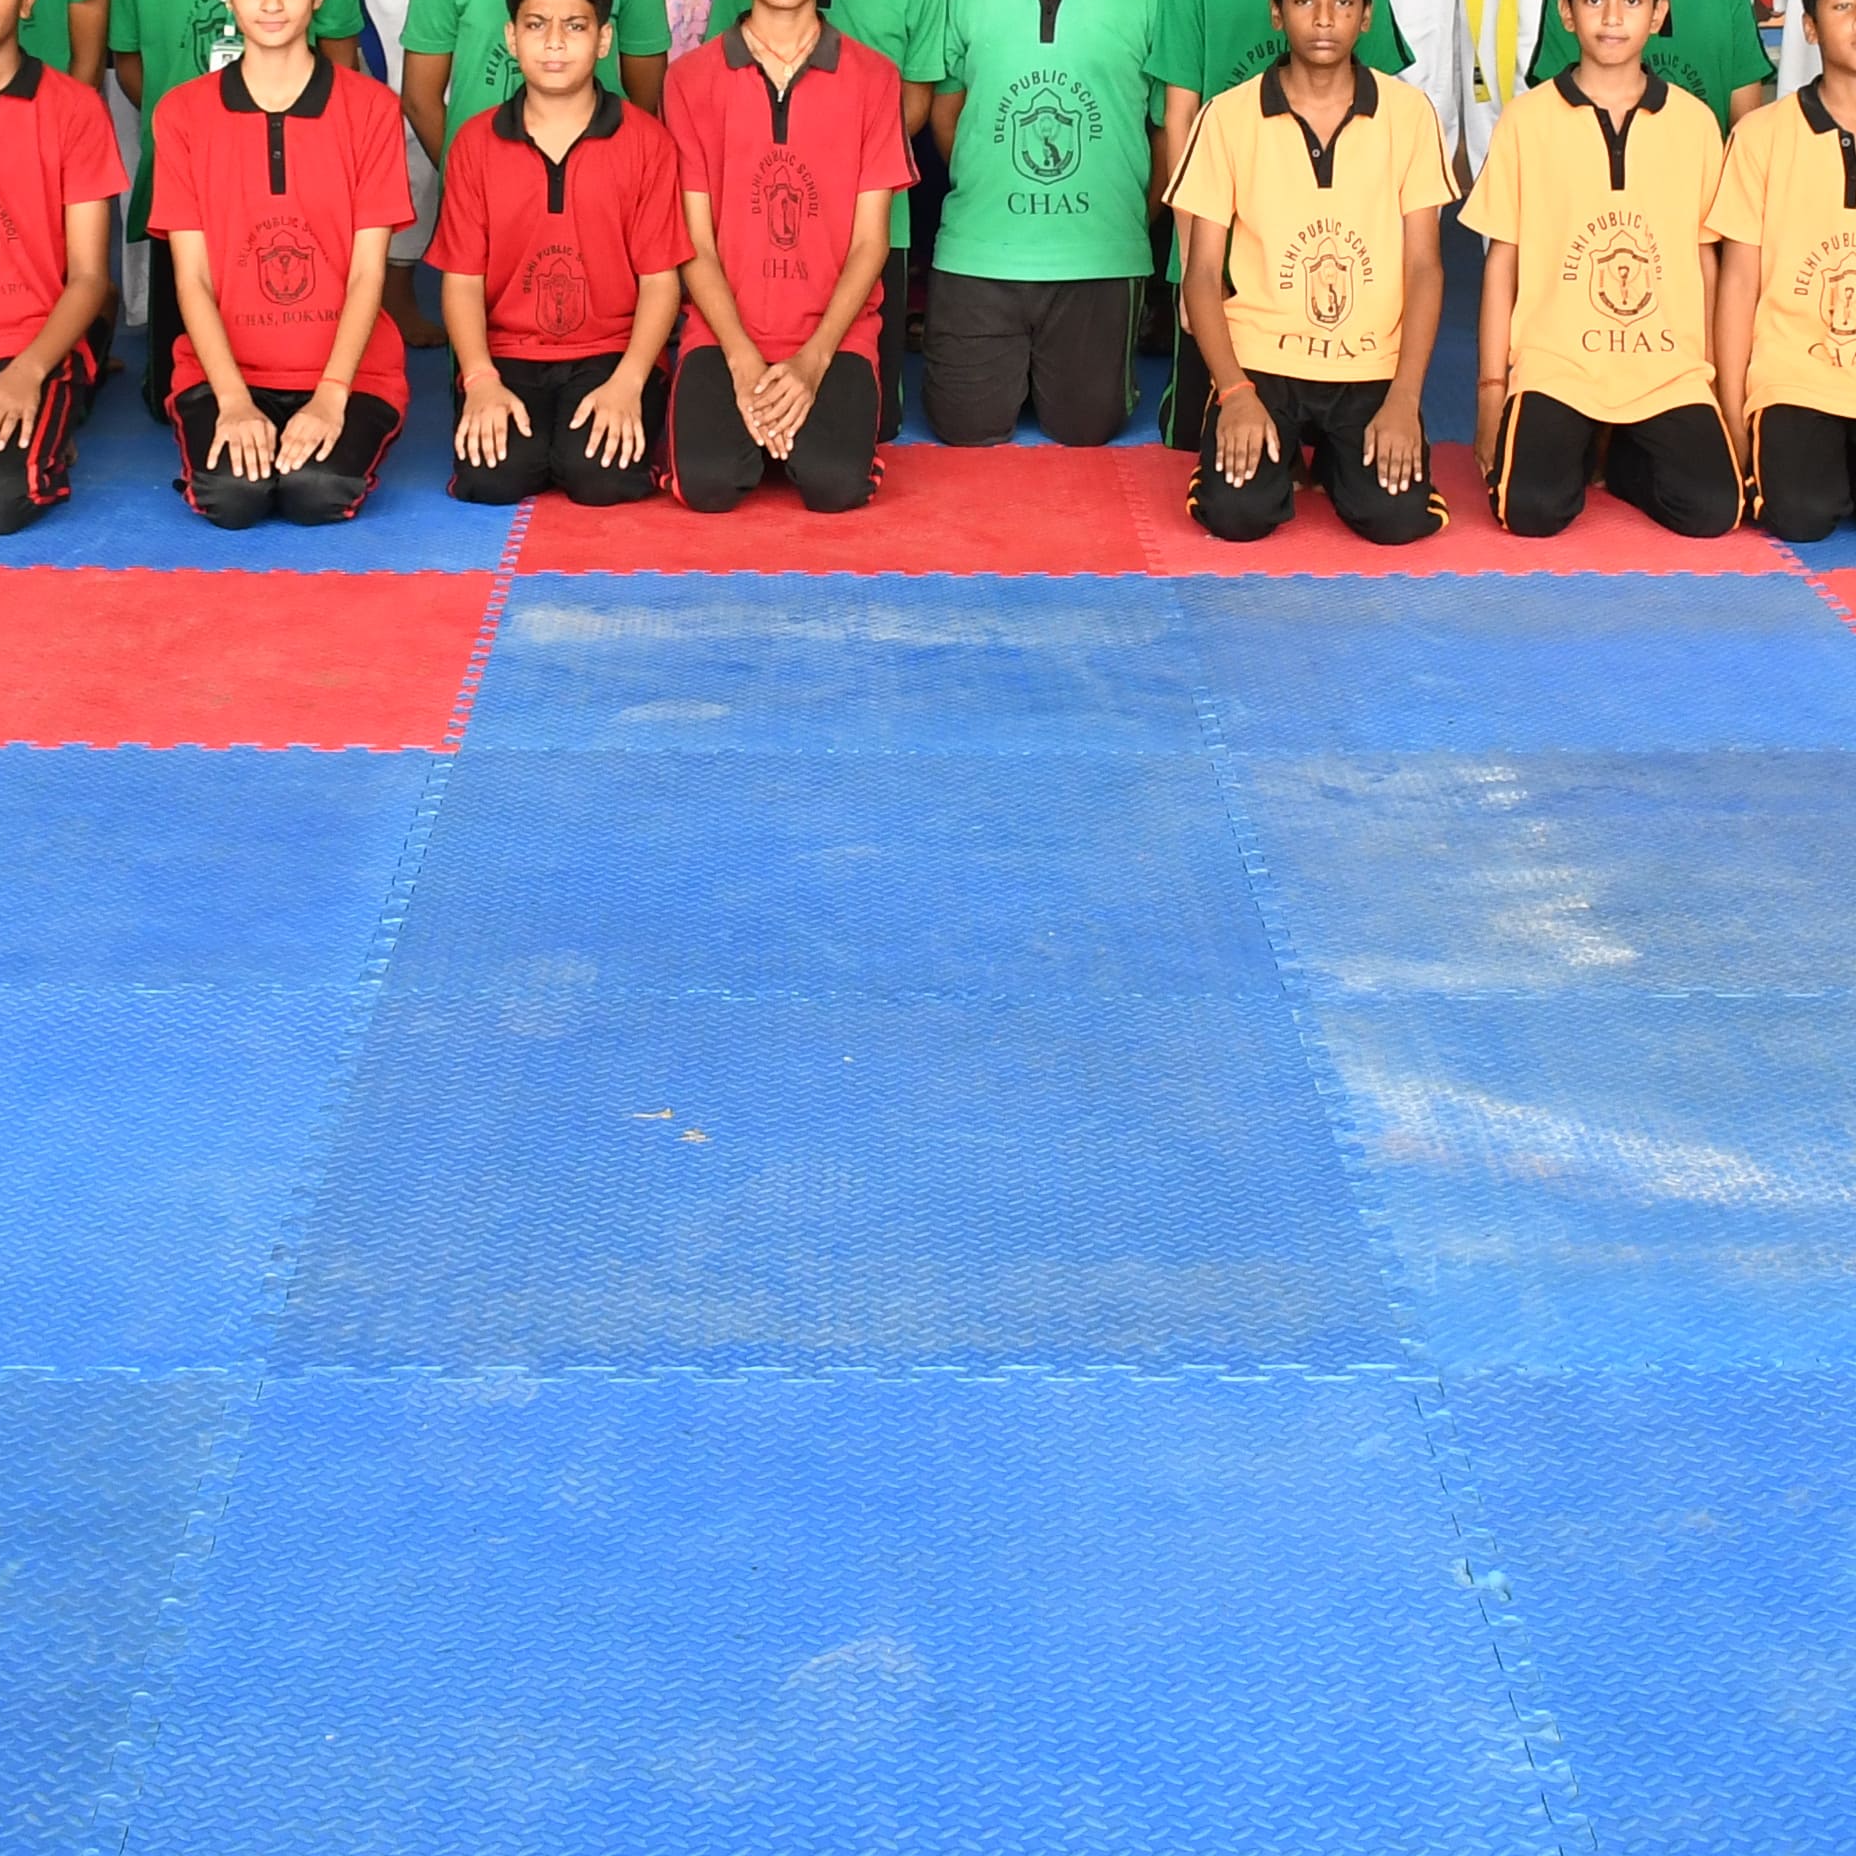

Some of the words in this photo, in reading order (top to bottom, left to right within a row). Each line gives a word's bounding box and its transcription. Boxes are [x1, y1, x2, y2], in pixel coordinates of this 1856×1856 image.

[486, 44, 508, 86] DELHI
[1247, 39, 1289, 64] PUBLI
[1681, 64, 1707, 97] SCHO
[994, 96, 1013, 144] DELHI
[1009, 69, 1068, 96] PUBLIC
[1070, 82, 1103, 142] SCHOOL
[751, 174, 762, 214] DELHI
[759, 149, 796, 174] PUBLIC
[797, 163, 818, 218] SCHOOL
[1007, 192, 1089, 215] CHAS
[536, 244, 573, 261] PUBLIC
[1280, 243, 1302, 289] DELHI
[1298, 218, 1342, 244] PUBLIC
[1344, 230, 1374, 285] SCHOOL
[1563, 235, 1589, 281] DELHI
[1587, 210, 1642, 236] PUBLIC
[762, 259, 809, 281] CHAS
[1794, 251, 1822, 295] DELHI
[1581, 329, 1675, 353] CHAS
